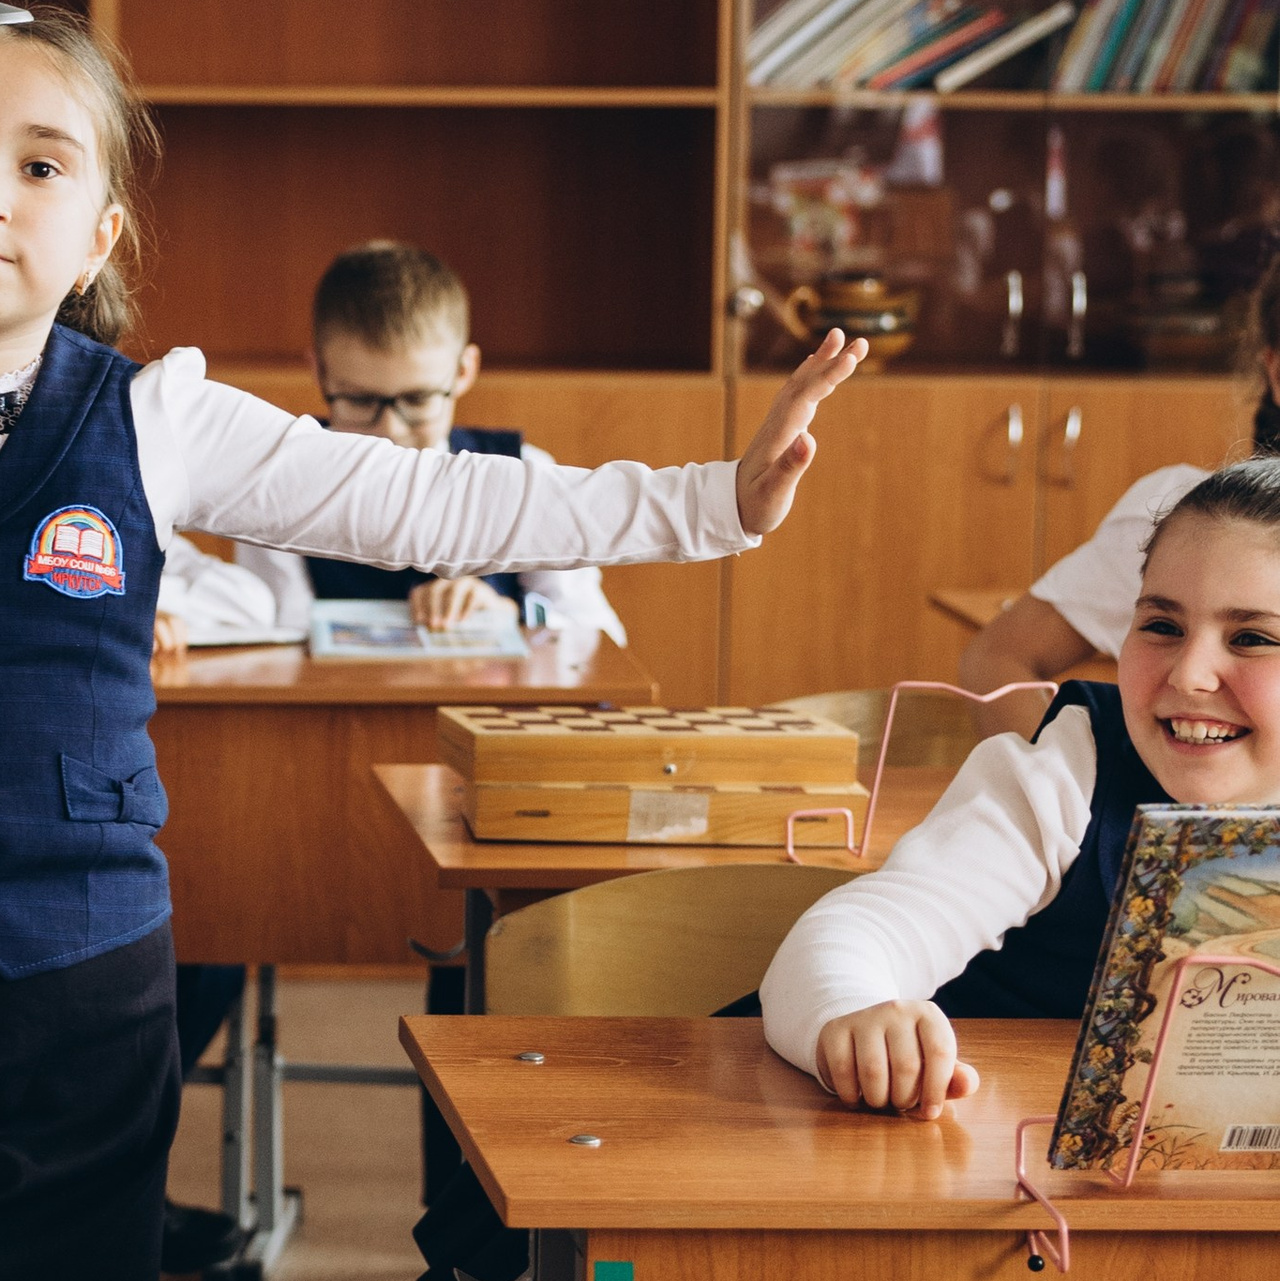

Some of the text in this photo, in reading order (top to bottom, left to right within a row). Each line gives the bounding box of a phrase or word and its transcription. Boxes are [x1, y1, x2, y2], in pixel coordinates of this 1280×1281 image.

[38, 555, 69, 568] МБОУ
[70, 559, 94, 571] СОШ
[53, 572, 102, 591] ИРКУТСК
